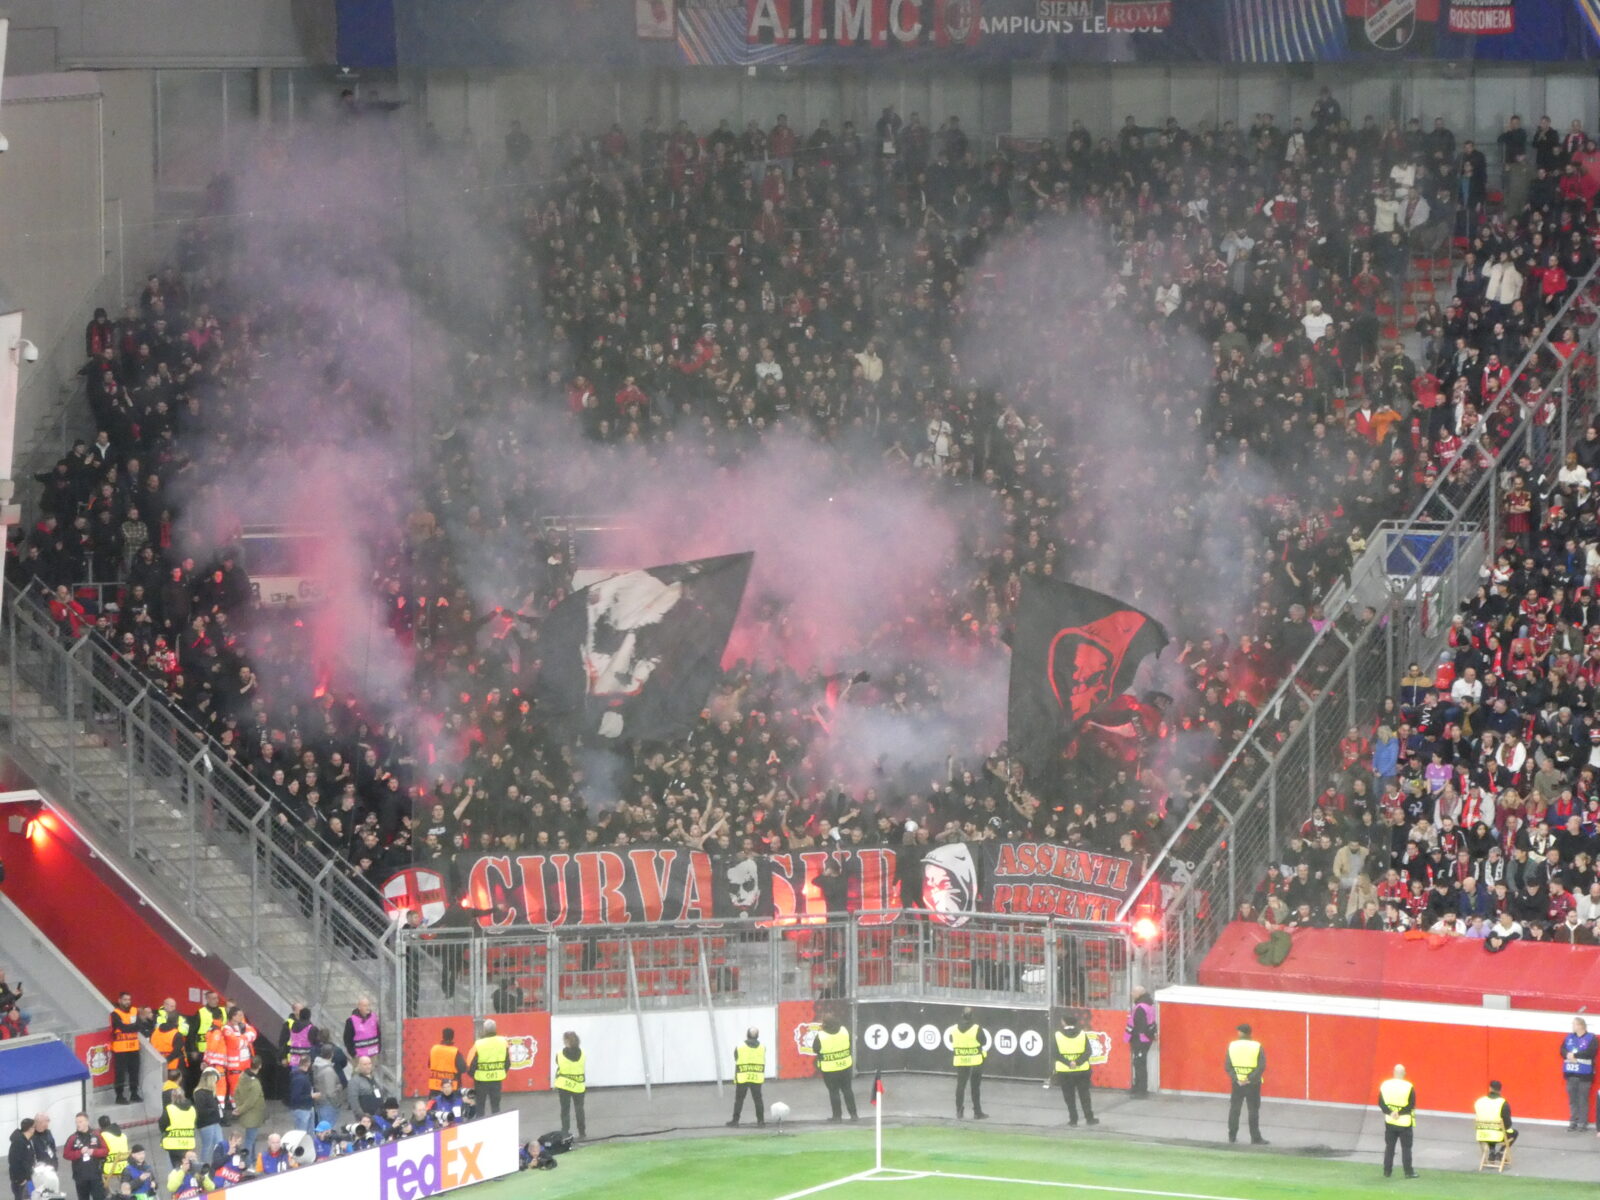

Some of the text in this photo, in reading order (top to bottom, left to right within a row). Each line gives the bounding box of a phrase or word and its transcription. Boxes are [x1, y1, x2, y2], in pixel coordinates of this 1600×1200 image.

[1039, 0, 1090, 17] SIENA
[1114, 5, 1170, 24] ROMA
[1449, 8, 1512, 29] ROSSONERA
[979, 16, 1074, 34] AMPIONS
[994, 843, 1133, 890] ASSENTI
[469, 849, 723, 934] CURVA
[993, 883, 1123, 921] PRESENTI
[168, 1129, 195, 1137] STEWAR
[380, 1126, 484, 1200] FedEx
